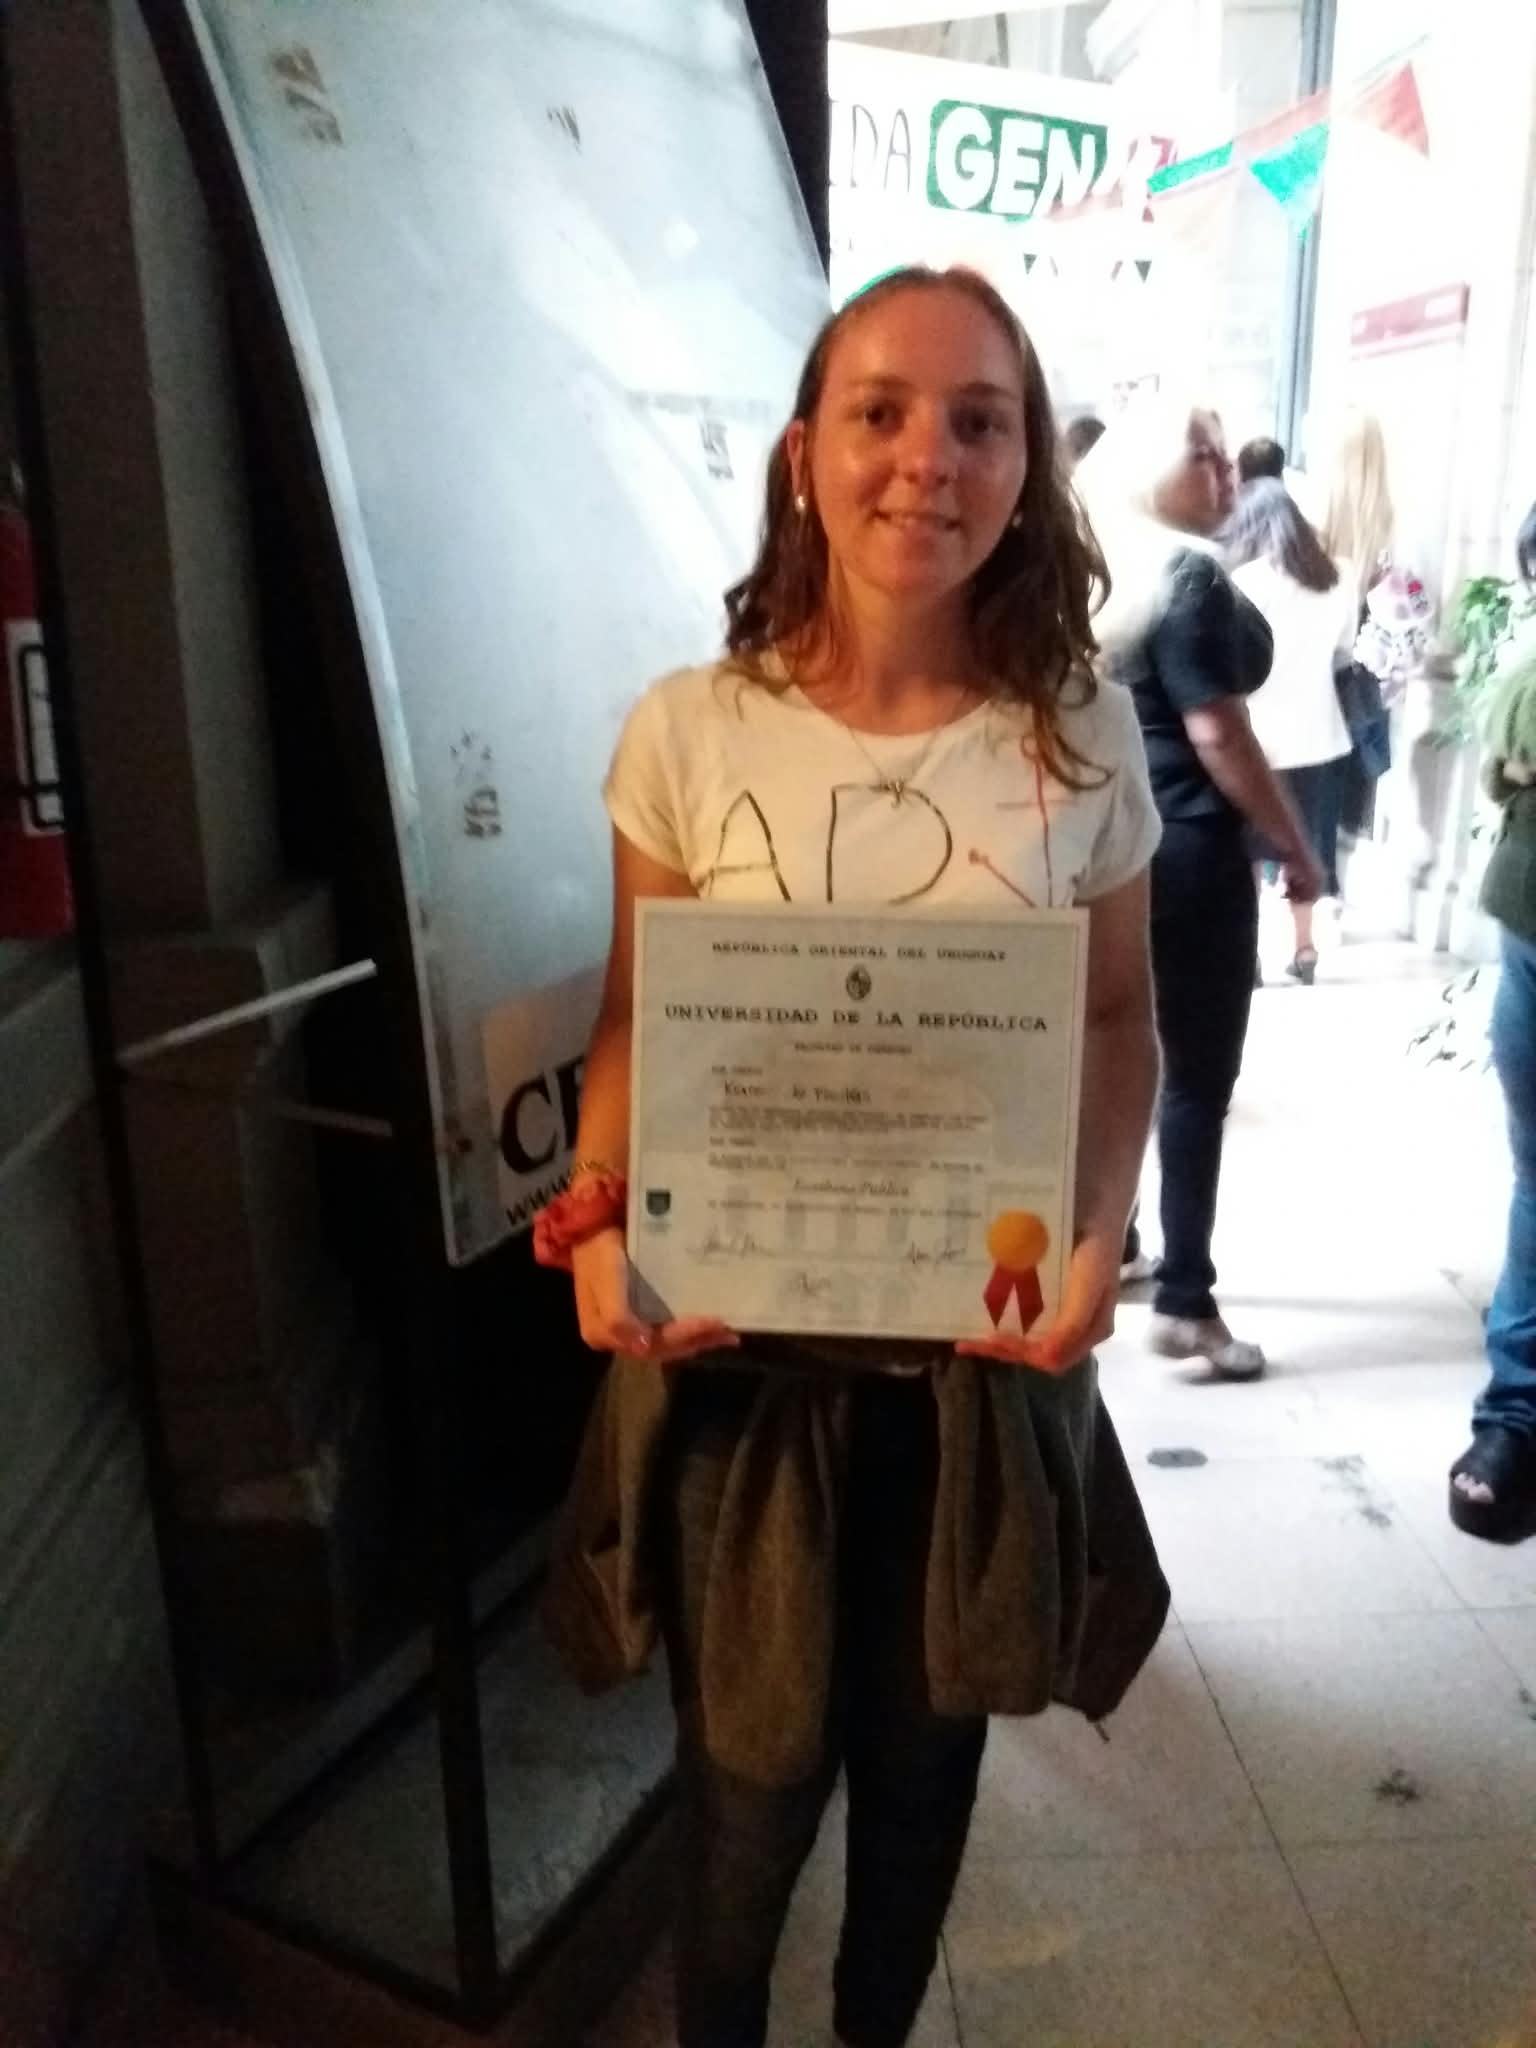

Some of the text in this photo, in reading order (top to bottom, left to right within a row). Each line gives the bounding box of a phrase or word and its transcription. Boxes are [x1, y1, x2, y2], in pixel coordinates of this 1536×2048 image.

[664, 1003, 819, 1024] UNIVERSIDAD
[833, 1010, 860, 1025] DE
[876, 1011, 903, 1027] LA
